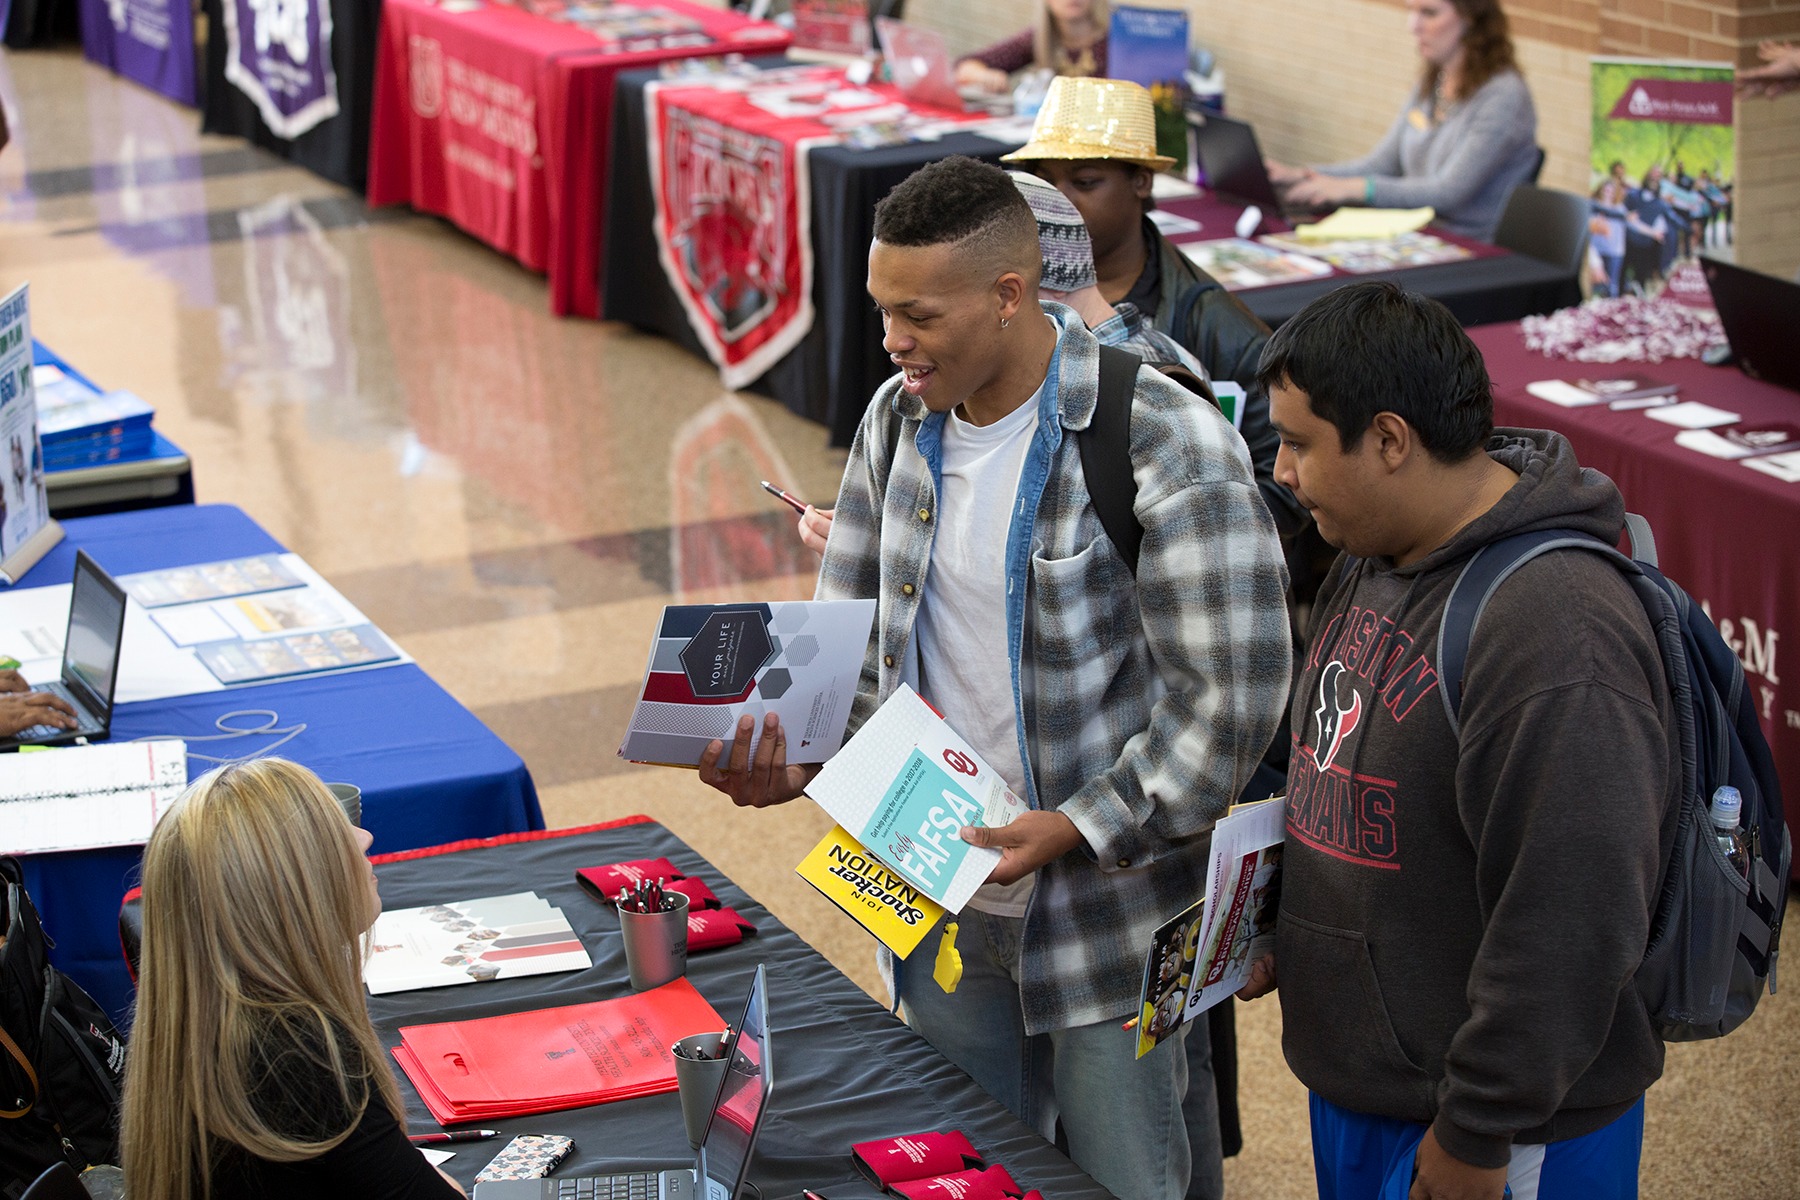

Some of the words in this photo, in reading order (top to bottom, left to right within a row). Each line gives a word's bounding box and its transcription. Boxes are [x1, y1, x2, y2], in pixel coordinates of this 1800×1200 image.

[710, 654, 724, 686] YOUR
[719, 621, 730, 647] LIFE
[943, 748, 979, 776] OU
[870, 827, 879, 838] Get
[875, 819, 885, 830] help
[881, 806, 893, 822] paying
[888, 799, 896, 807] for
[893, 785, 906, 801] college
[905, 757, 923, 780] 2017-2018
[887, 831, 915, 861] Early
[900, 788, 978, 889] FAFSA
[829, 844, 917, 903] NATION
[829, 866, 924, 925] Shocker
[851, 889, 882, 911] JOIN
[1210, 852, 1221, 918] SCHOLARSHIPS
[1220, 908, 1241, 958] BURSAR
[1238, 864, 1254, 902] GUIDE
[1154, 944, 1166, 1000] WICHITA
[1208, 960, 1224, 980] OU
[591, 1059, 609, 1075] TEXAS
[602, 1055, 623, 1077] HEALTH
